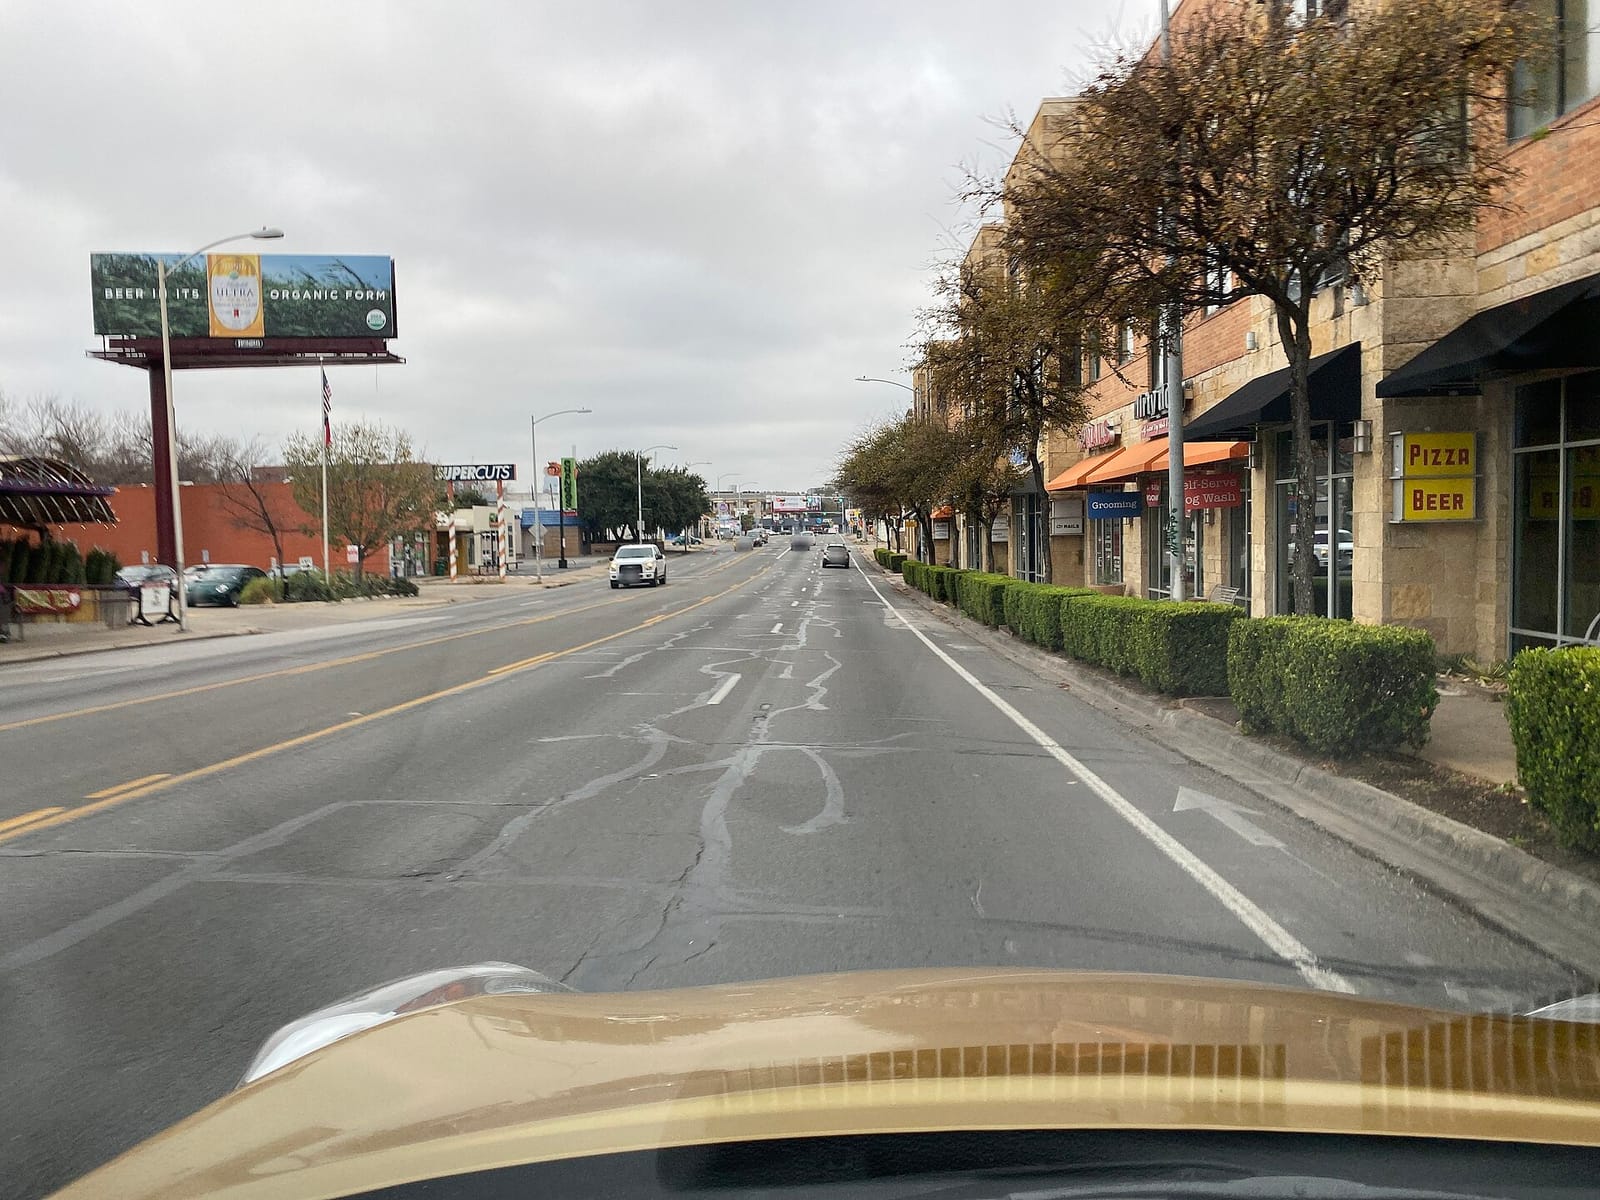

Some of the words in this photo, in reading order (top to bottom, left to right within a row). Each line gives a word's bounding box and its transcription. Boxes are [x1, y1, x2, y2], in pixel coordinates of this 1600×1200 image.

[104, 287, 144, 300] BEER
[176, 287, 200, 300] ITS
[270, 289, 338, 301] ORGANIC
[345, 289, 386, 301] FORM
[436, 465, 511, 481] SUPERCUTS
[1184, 479, 1237, 492] elf-Serve
[1091, 500, 1137, 510] Grooming
[1185, 495, 1200, 506] og
[1203, 492, 1236, 504] Wash
[1412, 489, 1464, 511] BEER
